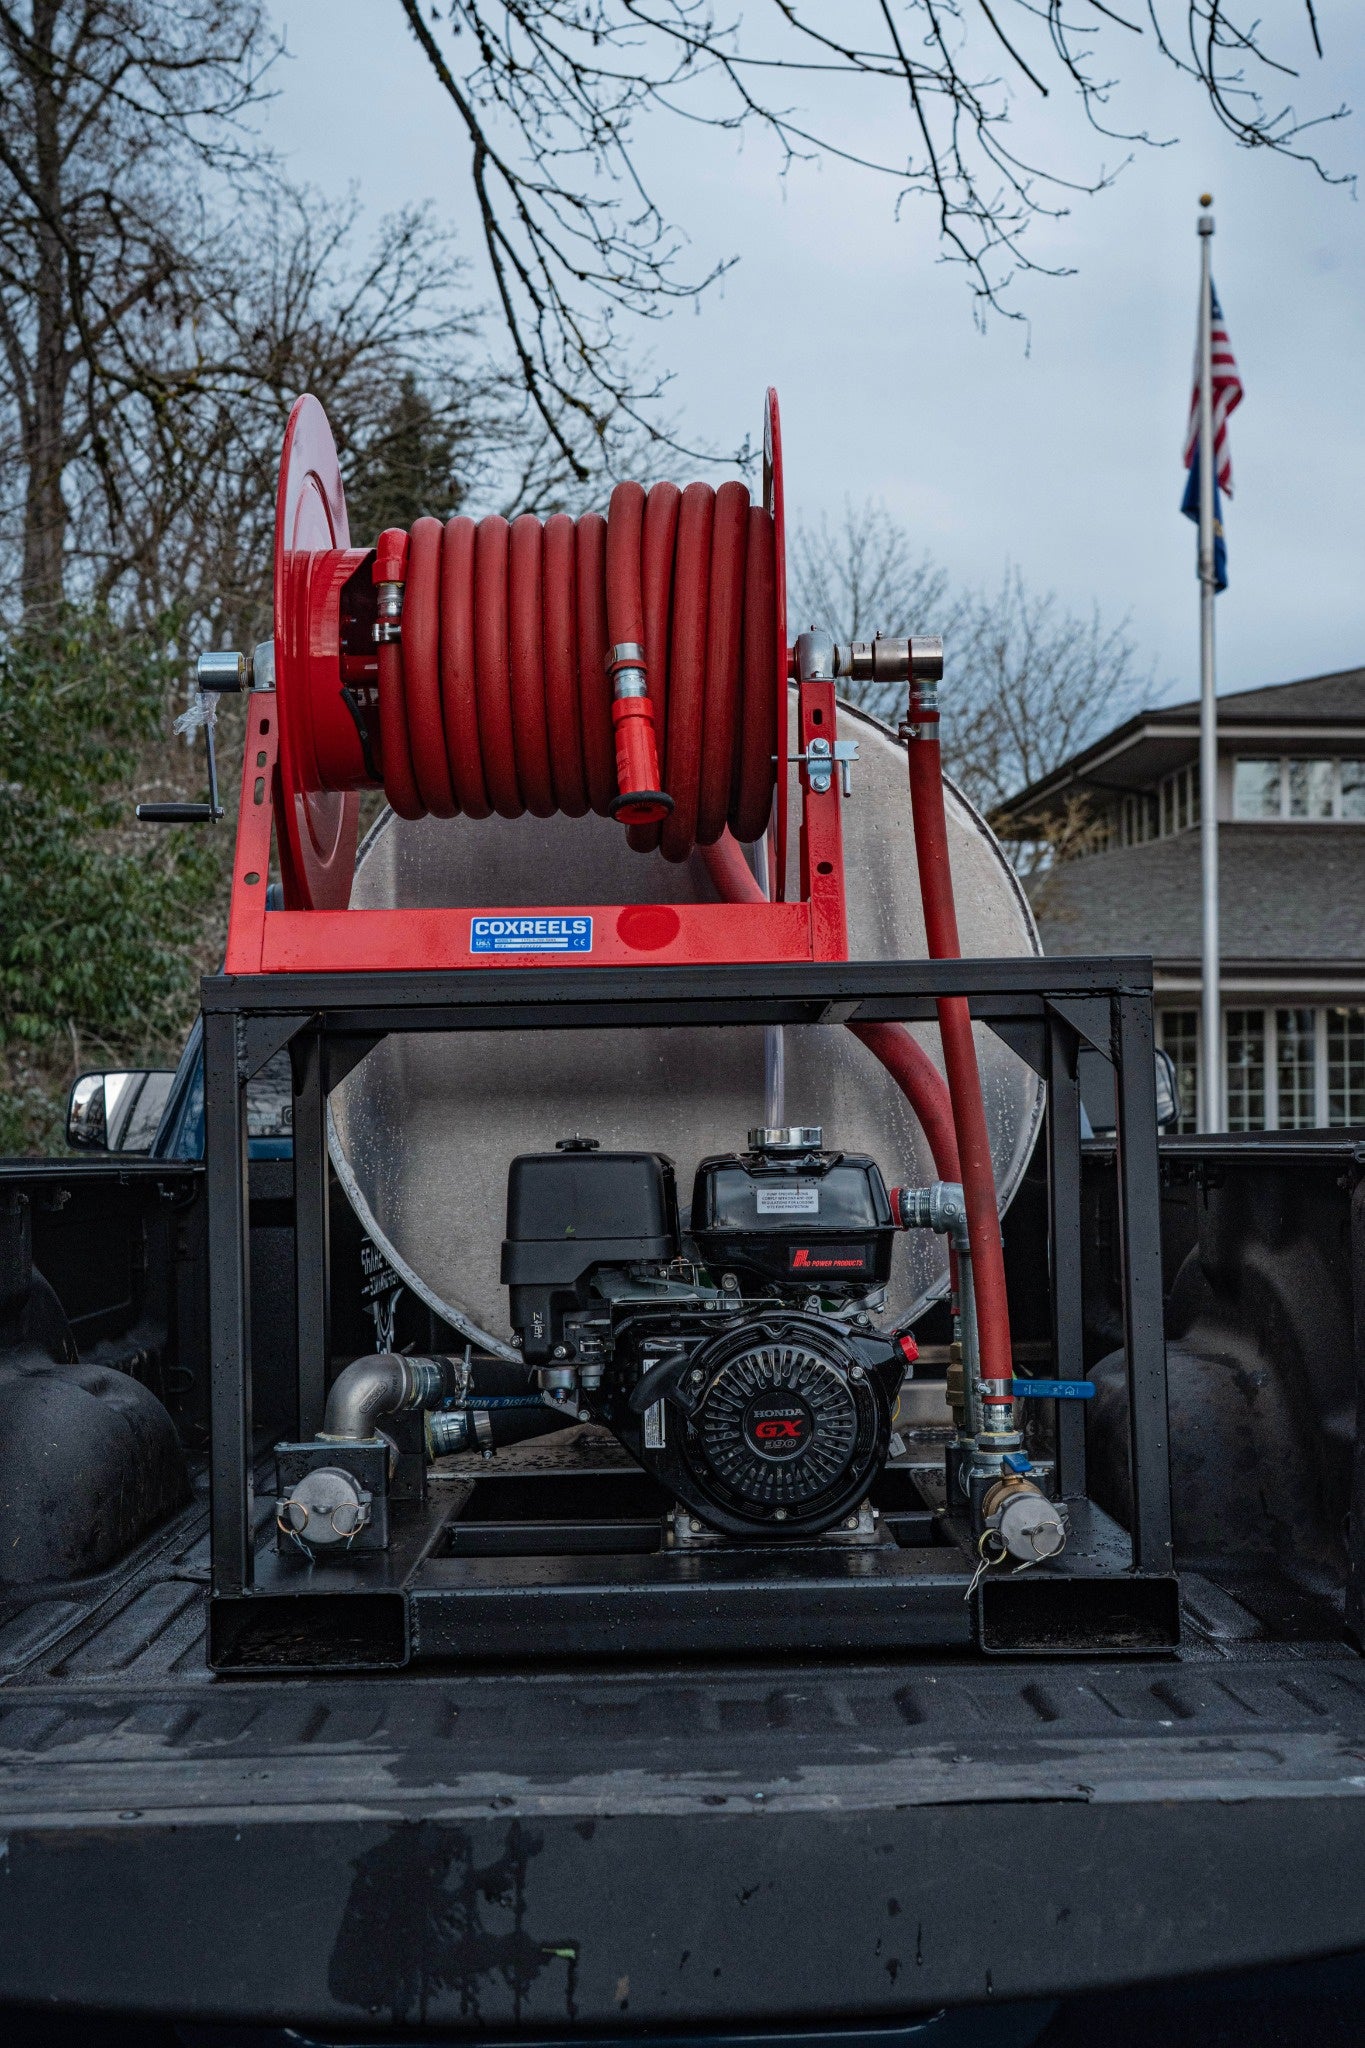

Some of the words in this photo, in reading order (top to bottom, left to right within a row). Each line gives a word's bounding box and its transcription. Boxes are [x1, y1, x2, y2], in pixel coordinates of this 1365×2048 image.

[475, 920, 587, 936] COXREELS
[833, 1259, 864, 1267] PRODUCTS
[490, 1399, 500, 1407] &
[753, 1408, 806, 1418] HONDA
[755, 1419, 804, 1439] GX
[764, 1438, 797, 1449] 390
